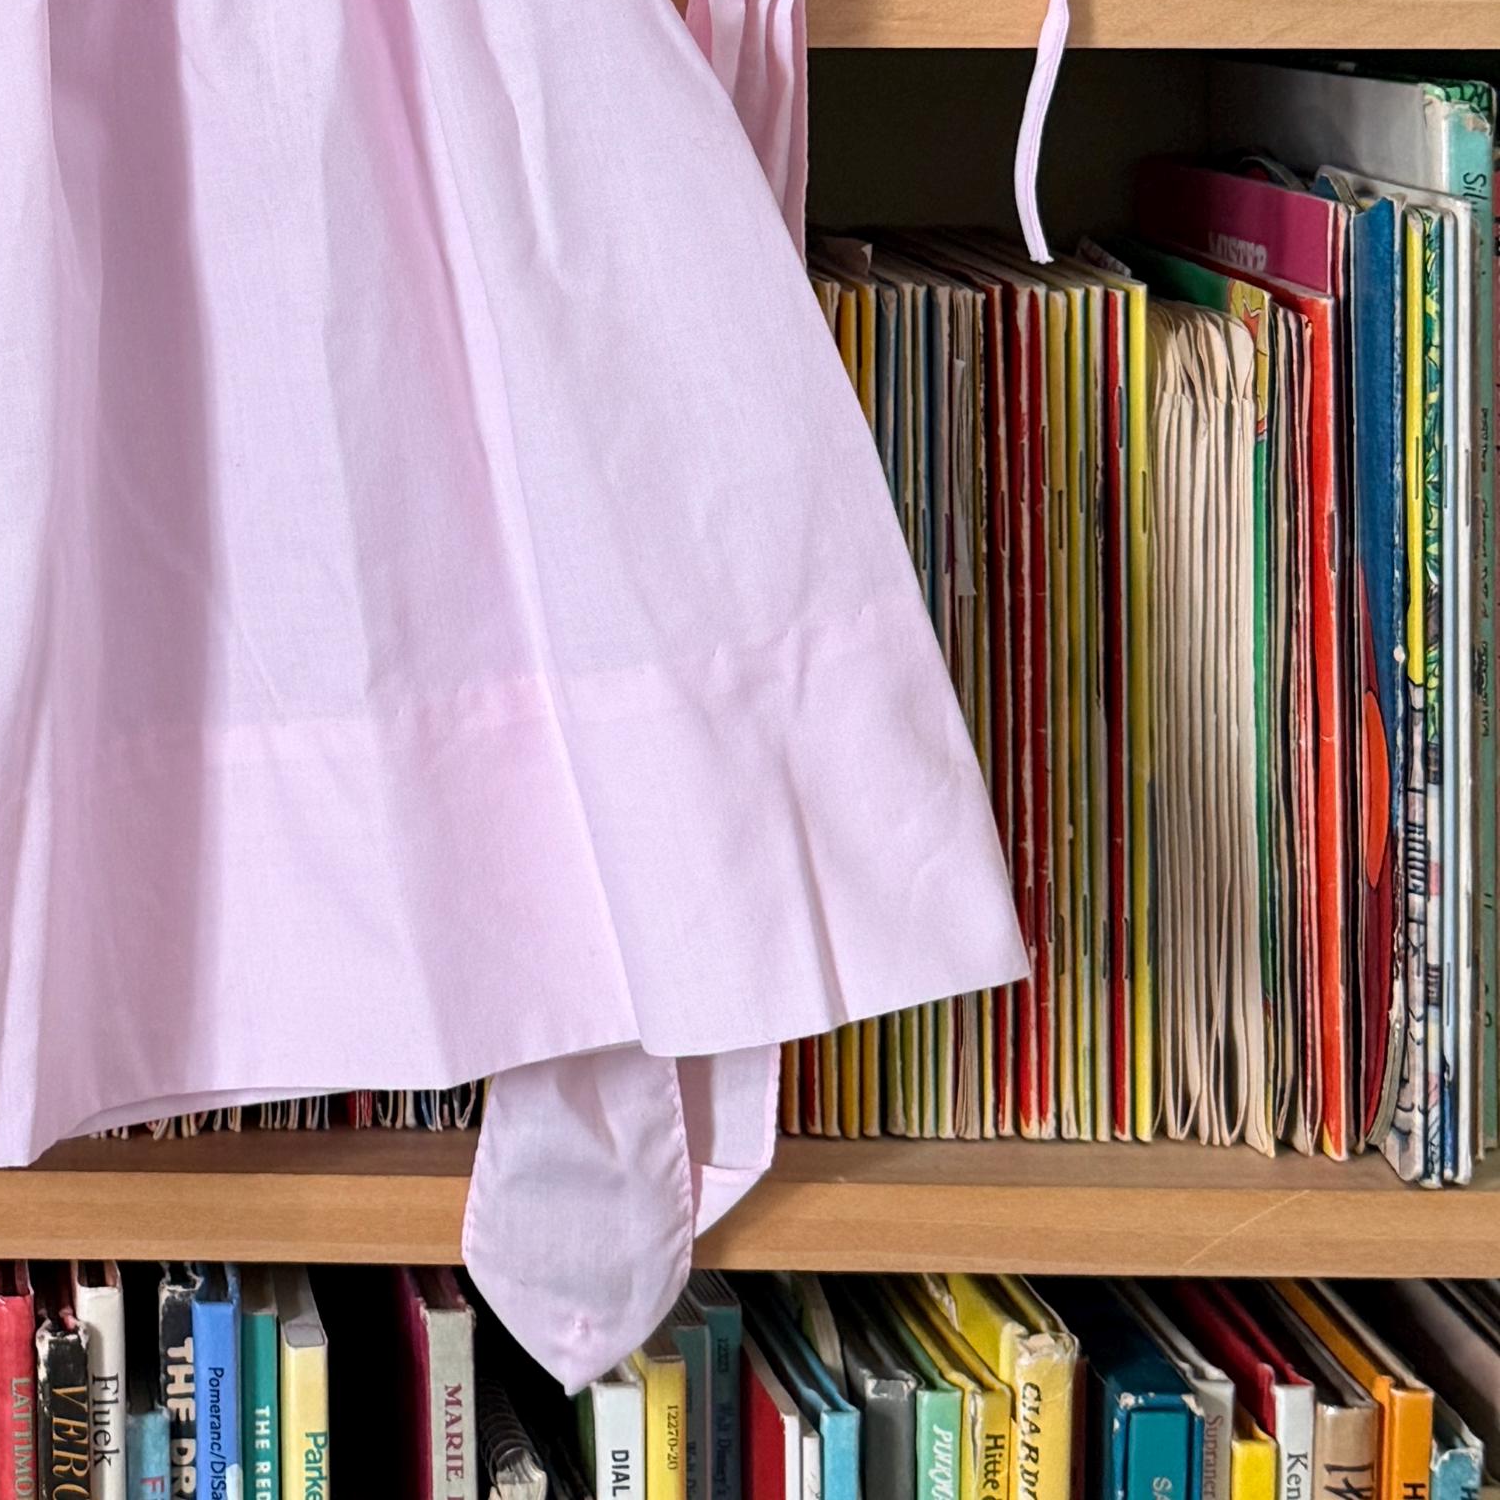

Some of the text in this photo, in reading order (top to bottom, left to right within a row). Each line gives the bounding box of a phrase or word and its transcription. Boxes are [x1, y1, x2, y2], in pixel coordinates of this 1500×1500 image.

[92, 1373, 120, 1468] Fluek
[166, 1337, 196, 1421] THE
[255, 1406, 271, 1449] THE
[444, 1383, 465, 1482] MARIE
[667, 1405, 679, 1470] 12270-20
[1203, 1414, 1224, 1498] Supraner
[612, 1450, 631, 1497] DIAL
